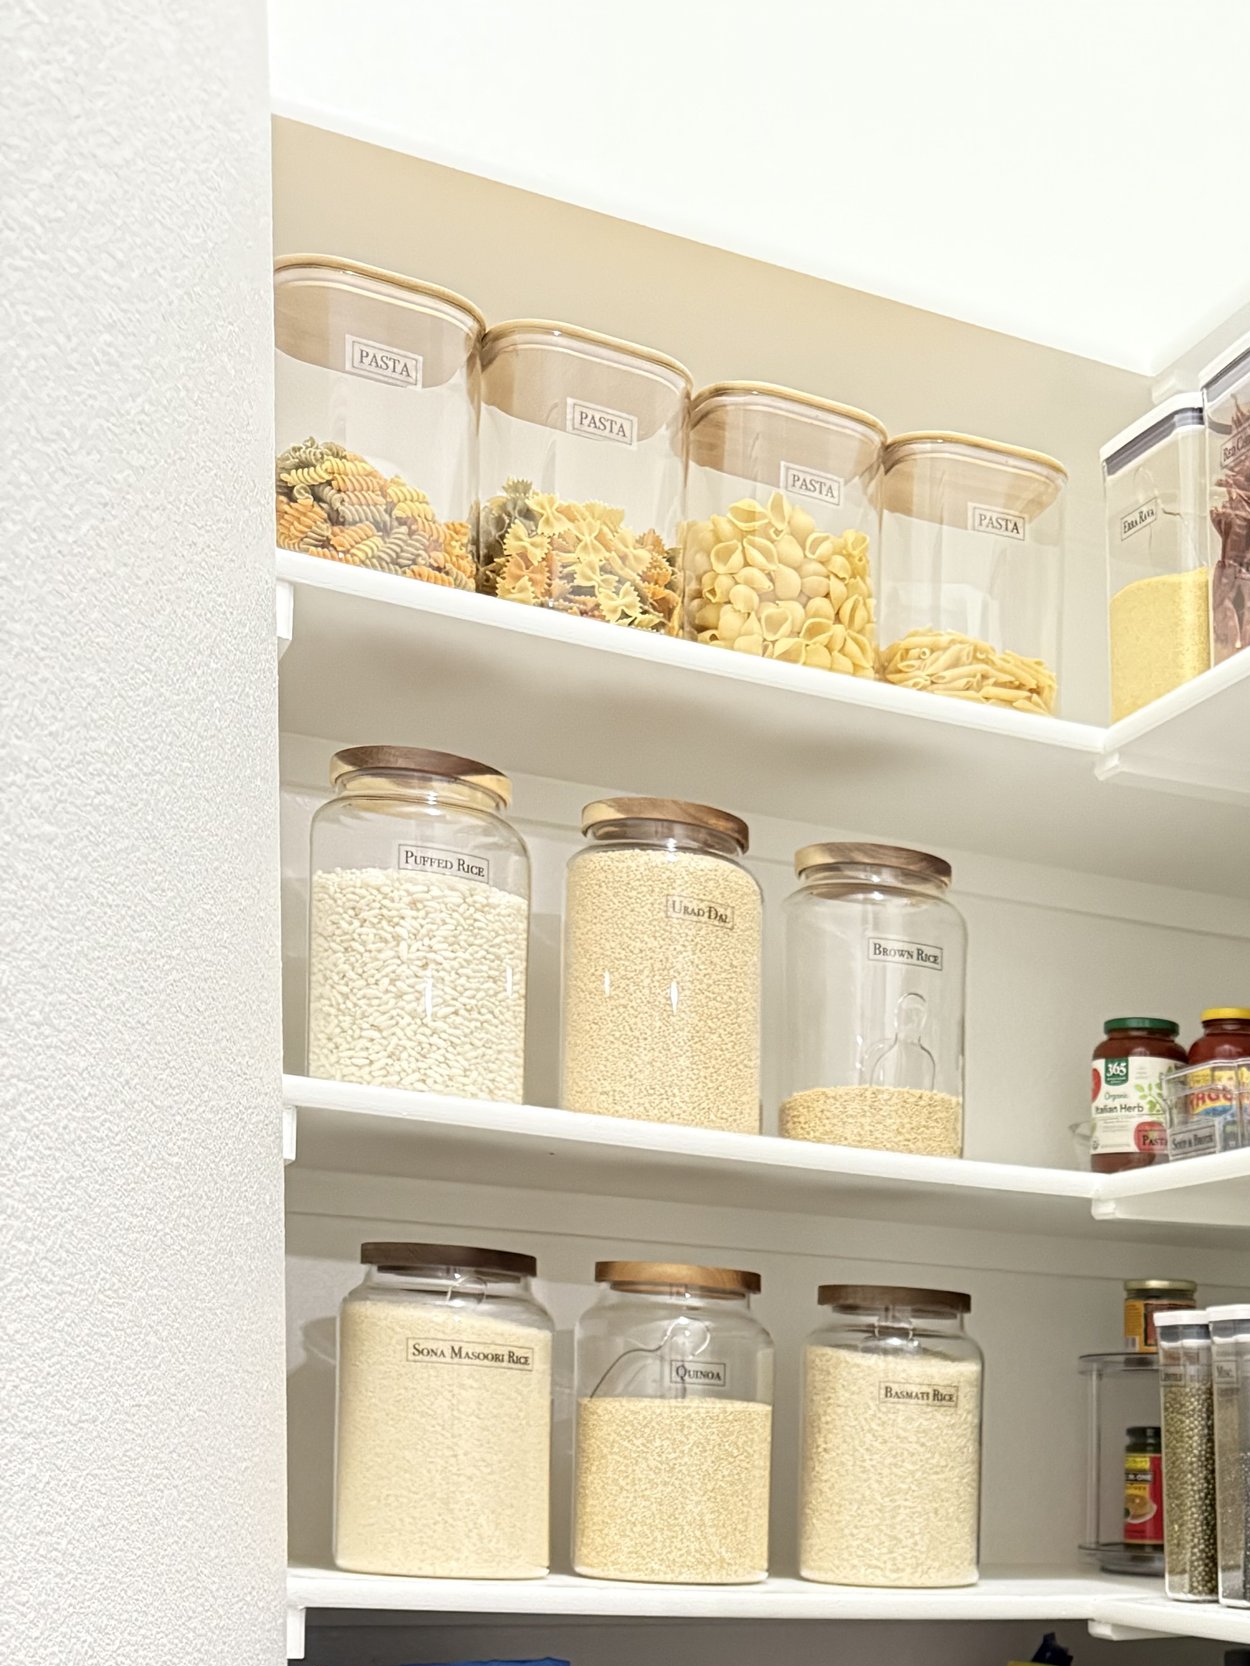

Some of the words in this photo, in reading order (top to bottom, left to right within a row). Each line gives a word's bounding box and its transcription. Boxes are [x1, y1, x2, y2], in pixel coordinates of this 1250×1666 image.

[356, 347, 413, 380] PASTA
[577, 409, 629, 440] PASTA
[789, 472, 837, 500] PASTA
[976, 512, 1022, 537] PASTA
[1138, 507, 1155, 526] RAVA
[404, 850, 454, 871] PUFFED
[457, 858, 486, 878] RICE
[672, 900, 705, 917] URAD
[706, 906, 731, 924] DAL
[873, 943, 914, 960] BROWN
[915, 948, 940, 966] RICE
[1106, 1062, 1127, 1077] 365
[1104, 1091, 1128, 1102] Organic
[1095, 1103, 1118, 1115] Italian
[1119, 1102, 1144, 1113] Herb
[412, 1342, 446, 1359] SONA
[450, 1345, 505, 1363] MASOORI
[507, 1350, 530, 1366] RICE
[675, 1363, 722, 1382] QUINOA
[884, 1385, 930, 1401] BASMATI
[932, 1388, 955, 1403] RICE
